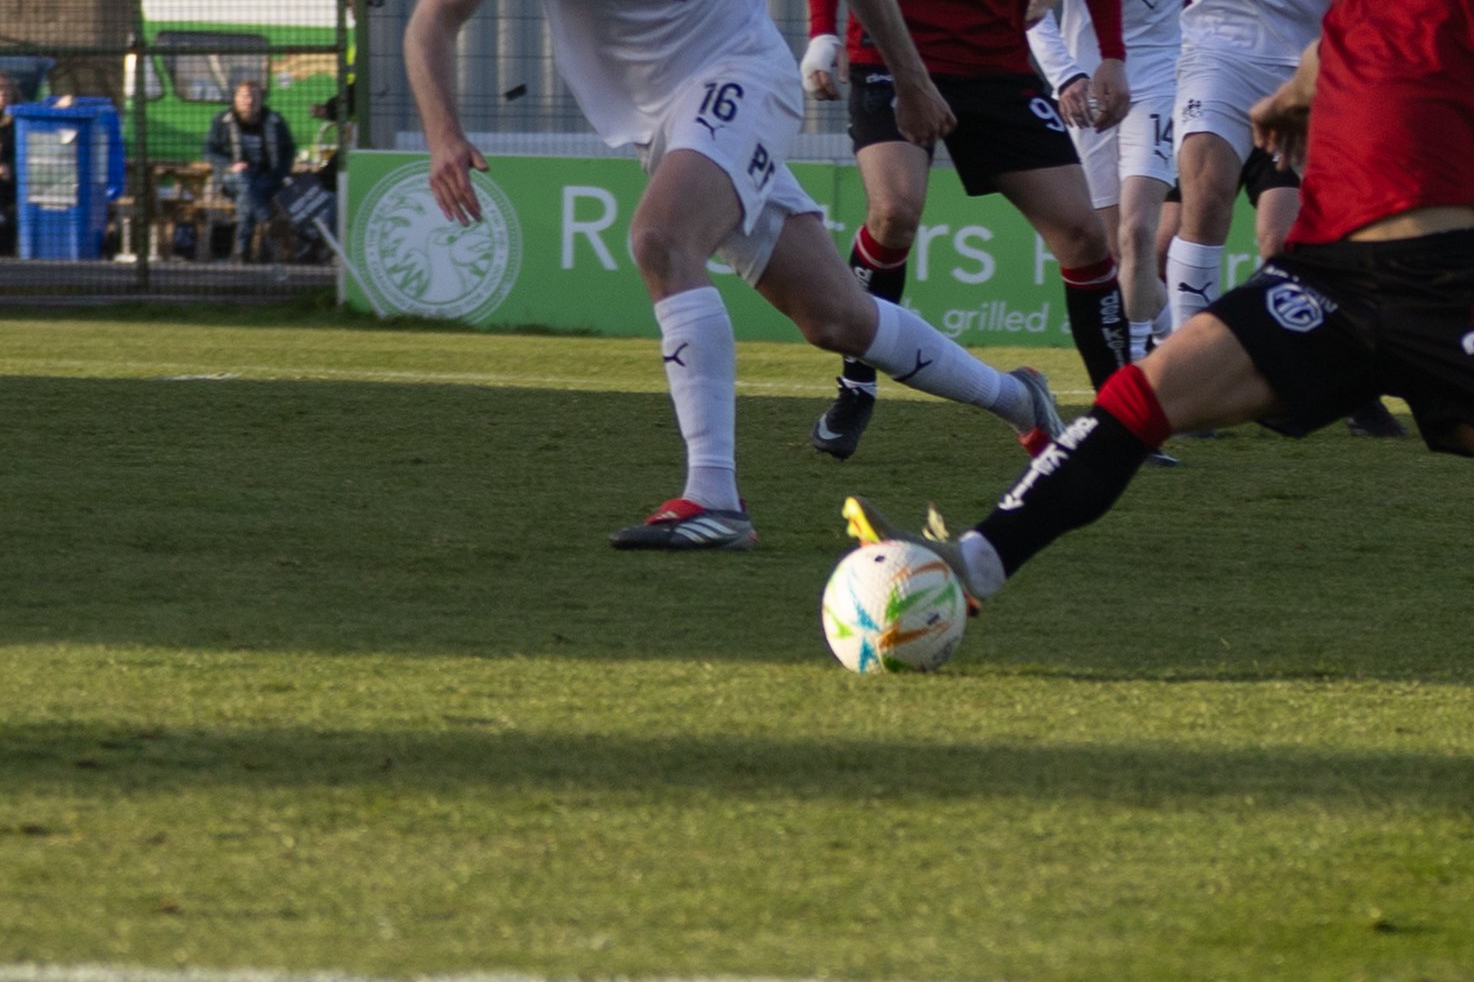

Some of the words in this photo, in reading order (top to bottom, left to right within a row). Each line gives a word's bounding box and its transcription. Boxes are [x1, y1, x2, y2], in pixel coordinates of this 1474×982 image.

[698, 82, 744, 122] 16
[1029, 98, 1066, 132] 9
[1149, 113, 1174, 150] 14
[943, 300, 1051, 339] grilled
